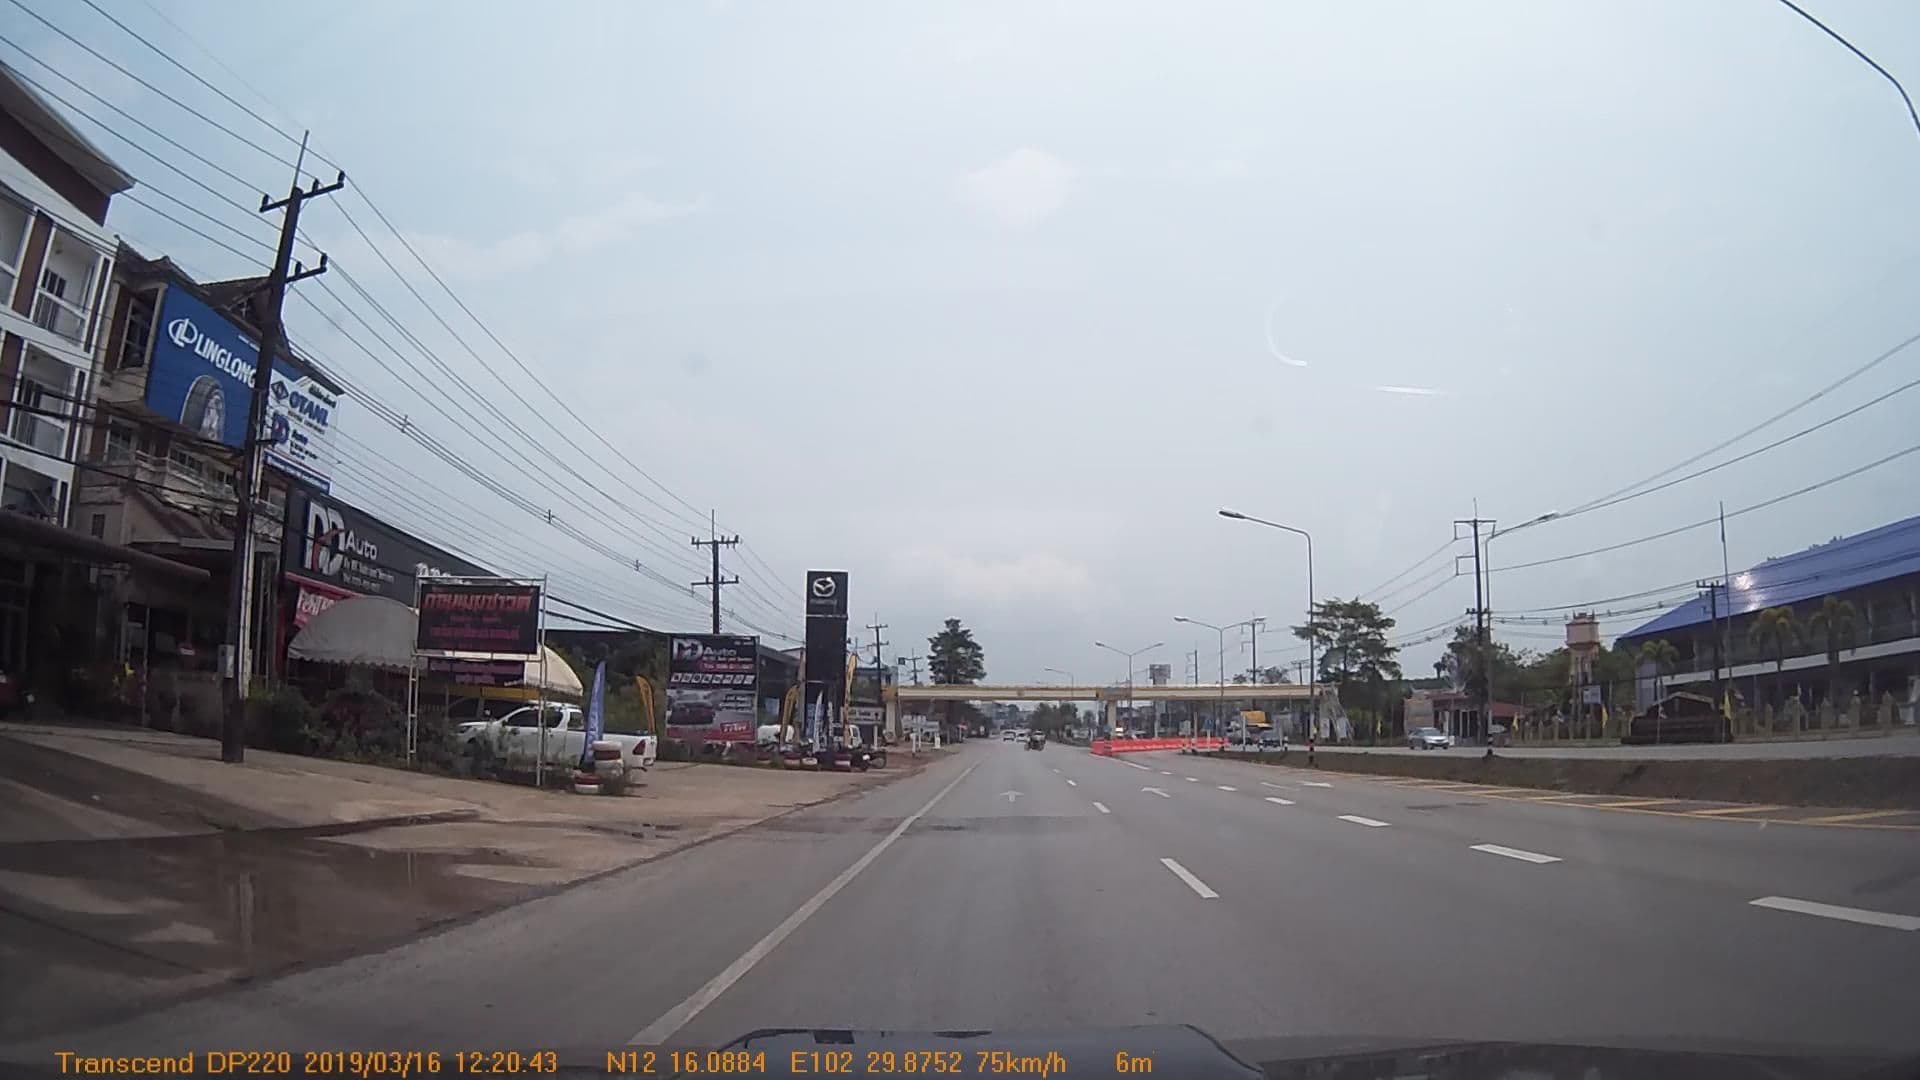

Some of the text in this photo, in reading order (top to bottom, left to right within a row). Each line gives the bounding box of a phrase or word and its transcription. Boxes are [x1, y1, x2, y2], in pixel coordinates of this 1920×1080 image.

[194, 333, 257, 388] LINGLONG
[289, 391, 328, 427] OTANI
[345, 530, 378, 561] Auto
[703, 647, 737, 657] Auto
